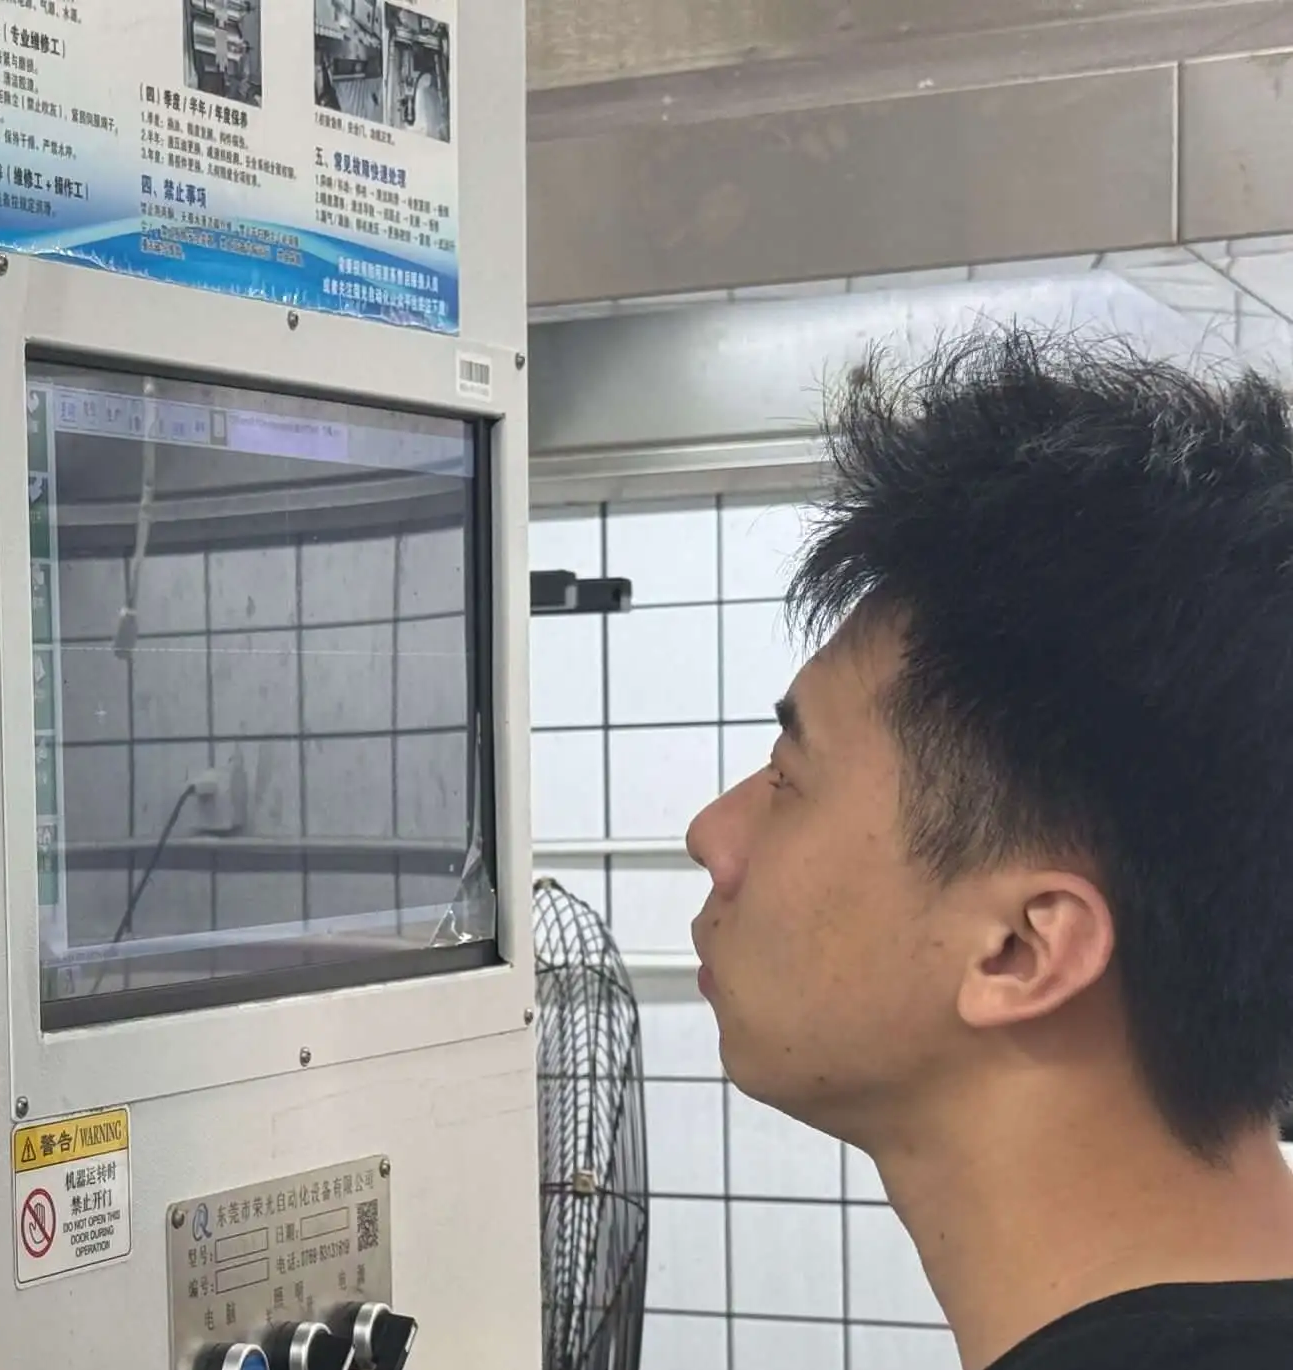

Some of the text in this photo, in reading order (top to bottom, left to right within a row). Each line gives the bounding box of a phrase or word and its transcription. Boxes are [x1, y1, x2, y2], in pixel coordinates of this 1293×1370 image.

[66, 1161, 116, 1191] 机器运转时
[72, 1190, 112, 1216] 禁止开门
[63, 1222, 73, 1233] DO
[88, 1214, 106, 1227] OPEN
[75, 1240, 110, 1258] OPERATION
